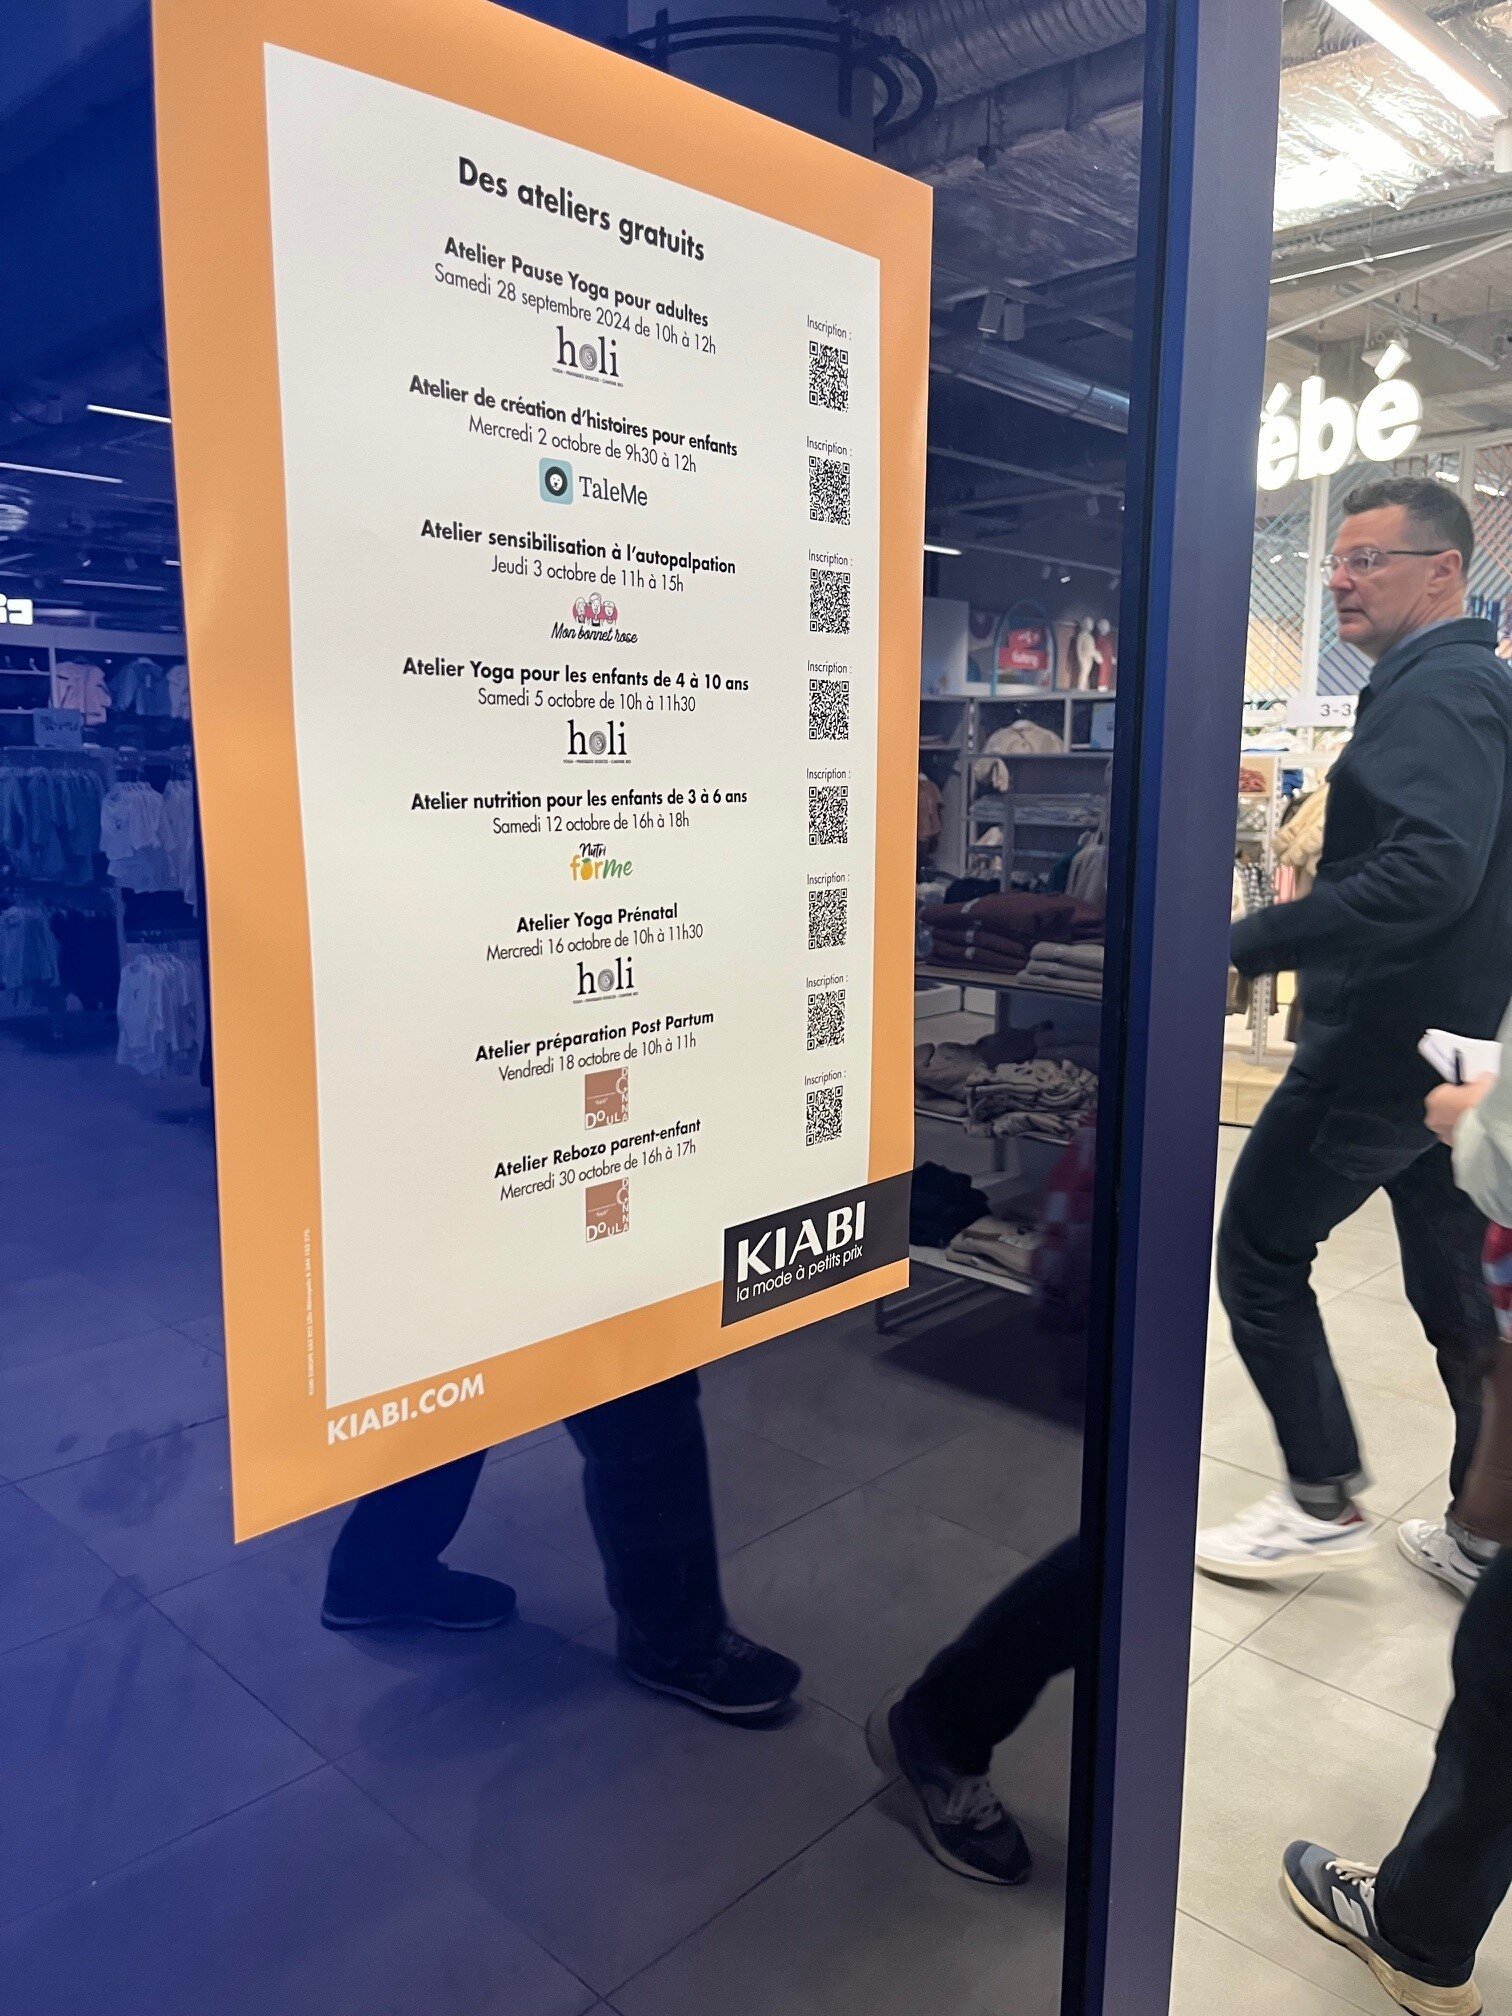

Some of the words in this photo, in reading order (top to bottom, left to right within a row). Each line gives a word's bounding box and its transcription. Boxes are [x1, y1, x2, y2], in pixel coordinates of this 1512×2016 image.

[459, 156, 508, 198] Des
[517, 184, 611, 231] ateliers
[619, 218, 705, 262] gratuits
[444, 236, 506, 270] Atelier
[512, 255, 564, 287] Pause
[567, 270, 609, 302] Yoga
[615, 290, 652, 311] pour
[655, 299, 709, 328] adultes
[435, 262, 491, 296] Samedi
[497, 279, 517, 302] 28
[522, 293, 592, 322] septembre
[596, 307, 631, 332] 2024
[634, 316, 651, 338] de
[656, 322, 678, 345] 10h
[681, 331, 690, 348] à
[695, 333, 716, 355] 12h
[807, 314, 847, 339] Inscription
[409, 375, 469, 403] Atelier
[473, 387, 496, 409] de
[500, 396, 567, 423] création
[571, 407, 649, 439] d'histoires
[652, 429, 686, 446] pour
[689, 434, 738, 457] enfants
[1257, 340, 1423, 491] ébé
[469, 414, 533, 443] Mercredi
[538, 427, 548, 446] 2
[551, 433, 602, 456] octobre
[605, 439, 622, 459] de
[625, 443, 658, 466] 9h30
[661, 452, 670, 468] à
[675, 453, 697, 473] 12h
[806, 436, 848, 457] Inscription
[579, 476, 648, 507] TaleMe
[420, 519, 483, 544] Atelier
[488, 531, 606, 559] sensibilisation
[611, 543, 622, 561] à
[627, 543, 736, 574] l'autopalpation
[808, 549, 849, 568] Inscription
[492, 555, 528, 576] Jeudi
[533, 559, 543, 577] 3
[547, 562, 597, 583] octobre
[600, 565, 617, 585] de
[622, 569, 645, 588] 11h
[648, 573, 657, 590] à
[662, 574, 684, 592] 15h
[551, 621, 577, 640] Mon
[577, 625, 614, 642] bonnet
[614, 628, 639, 643] rose
[402, 656, 466, 677] Atelier
[469, 660, 515, 684] Yoga
[520, 668, 560, 685] pour
[565, 664, 587, 684] les
[592, 667, 649, 687] enfants
[653, 670, 672, 688] de
[676, 672, 686, 688] 4
[690, 672, 699, 689] à
[705, 674, 722, 690] 10
[725, 679, 749, 691] ans
[807, 659, 848, 677] Inscription
[478, 687, 530, 707] Samedi
[535, 690, 544, 707] 5
[548, 689, 596, 709] octobre
[599, 691, 615, 710] de
[620, 692, 642, 711] 10h
[646, 695, 654, 711] à
[659, 694, 696, 712] 11h30
[807, 768, 847, 783] Inscription
[411, 791, 469, 811] Atelier
[473, 791, 542, 809] nutrition
[546, 795, 583, 812] pour
[587, 789, 607, 807] les
[611, 788, 663, 807] enfants
[667, 788, 684, 805] de
[688, 789, 697, 805] 3
[700, 788, 709, 804] à
[713, 788, 722, 804] 6
[725, 792, 748, 804] ans
[493, 814, 541, 835] Samedi
[546, 816, 563, 832] 12
[566, 812, 611, 832] octobre
[613, 812, 629, 830] de
[633, 811, 654, 829] 16h
[657, 814, 665, 828] à
[669, 810, 690, 828] 18h
[807, 871, 846, 887] Inscription
[517, 913, 571, 934] Atelier
[574, 911, 613, 931] Yoga
[618, 902, 678, 924] Prénatal
[486, 938, 543, 962] Mercredi
[548, 937, 565, 954] 16
[567, 932, 612, 953] octobre
[614, 930, 630, 947] de
[633, 927, 655, 945] 10h
[657, 928, 665, 943] à
[669, 923, 704, 941] 11h30
[806, 973, 844, 989] Inscription
[475, 1039, 531, 1063] Atelier
[536, 1025, 627, 1057] préparation
[632, 1018, 662, 1036] Post
[665, 1013, 714, 1031] Partum
[498, 1056, 554, 1082] Vendredi
[559, 1054, 575, 1071] 18
[578, 1047, 621, 1068] octobre
[623, 1043, 638, 1060] de
[642, 1038, 663, 1056] 10h
[665, 1038, 673, 1053] à
[677, 1033, 697, 1050] 11h
[804, 1069, 842, 1086] Inscription
[494, 1155, 549, 1180] Atelier
[553, 1143, 607, 1165] Rebozo
[610, 1119, 702, 1156] parent-enfant
[500, 1172, 555, 1202] Mercredi
[559, 1169, 576, 1187] 30
[578, 1159, 622, 1182] octobre
[624, 1153, 638, 1171] de
[642, 1147, 663, 1166] 16h
[665, 1146, 673, 1160] à
[677, 1139, 696, 1158] 17h
[737, 1200, 866, 1283] KIABI
[736, 1286, 749, 1302] la
[752, 1271, 792, 1297] mode
[795, 1265, 805, 1281] à
[808, 1254, 841, 1280] petits
[842, 1244, 863, 1267] prix
[327, 1372, 485, 1445] KIABI.COM
